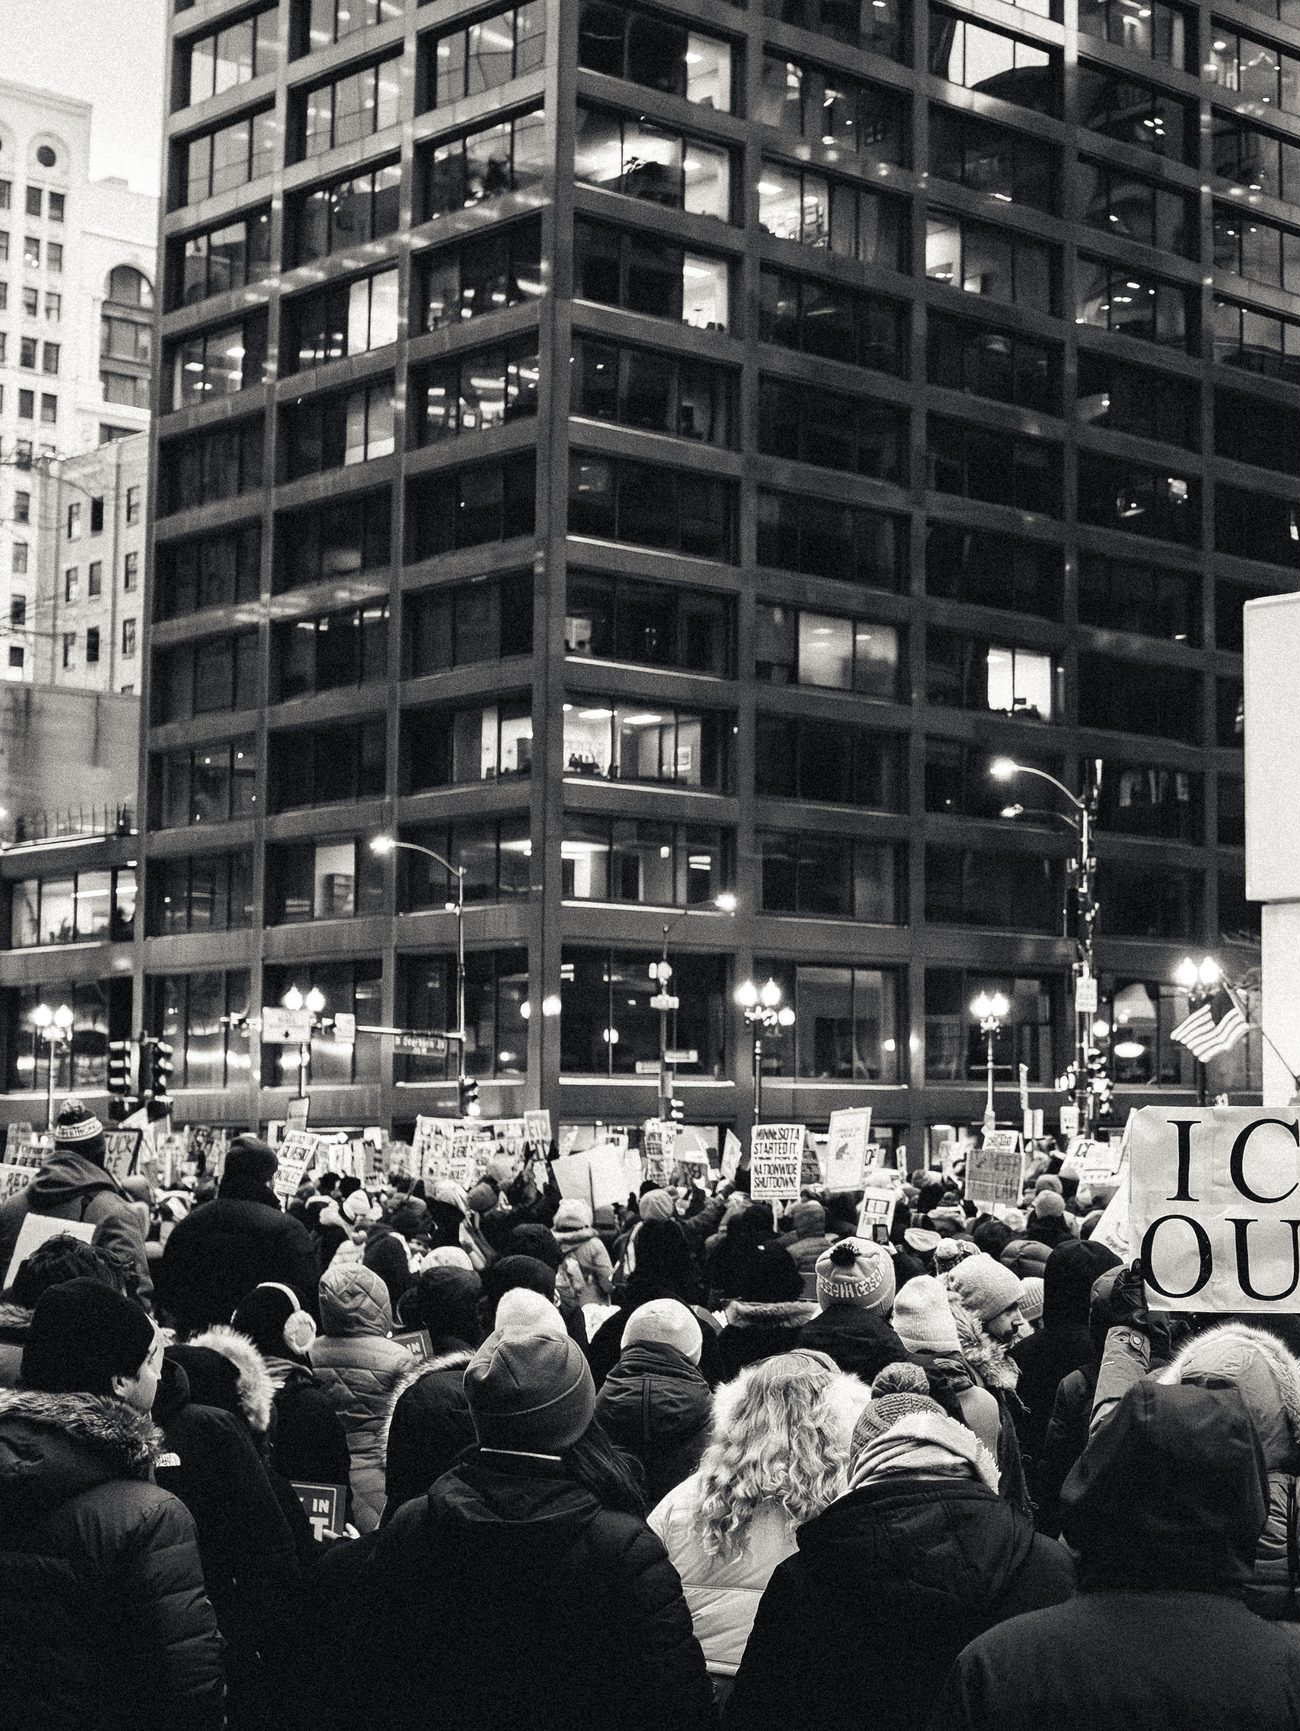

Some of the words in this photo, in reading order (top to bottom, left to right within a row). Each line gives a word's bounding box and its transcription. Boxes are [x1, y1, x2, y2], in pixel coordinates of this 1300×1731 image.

[756, 1128, 800, 1140] MINNESOTA
[105, 1134, 131, 1154] UCK
[753, 1142, 788, 1154] STARTED
[753, 1163, 797, 1175] NATIONWIDE
[312, 1498, 330, 1514] IN
